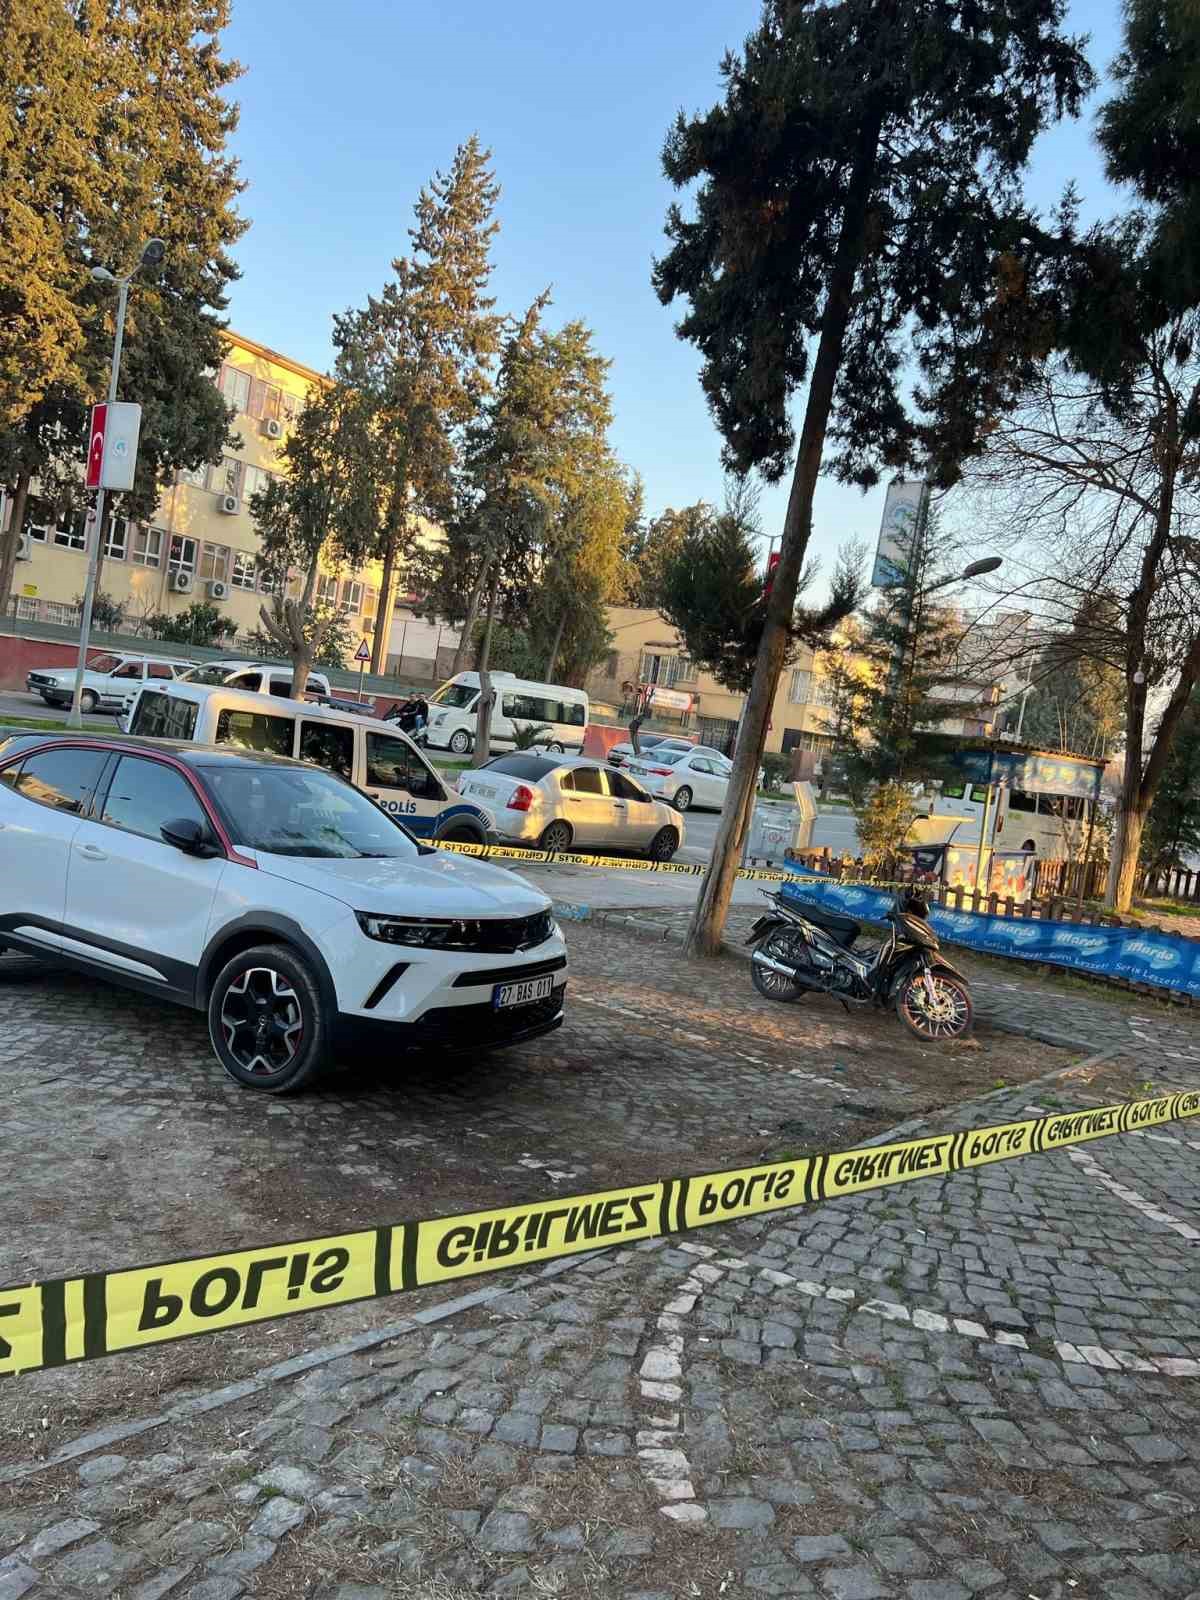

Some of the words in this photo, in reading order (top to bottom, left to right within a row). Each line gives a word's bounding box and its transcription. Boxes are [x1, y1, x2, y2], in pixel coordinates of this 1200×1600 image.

[380, 799, 416, 814] POLİS
[501, 987, 513, 1004] 27
[517, 983, 533, 1001] BAS
[537, 977, 551, 996] 011
